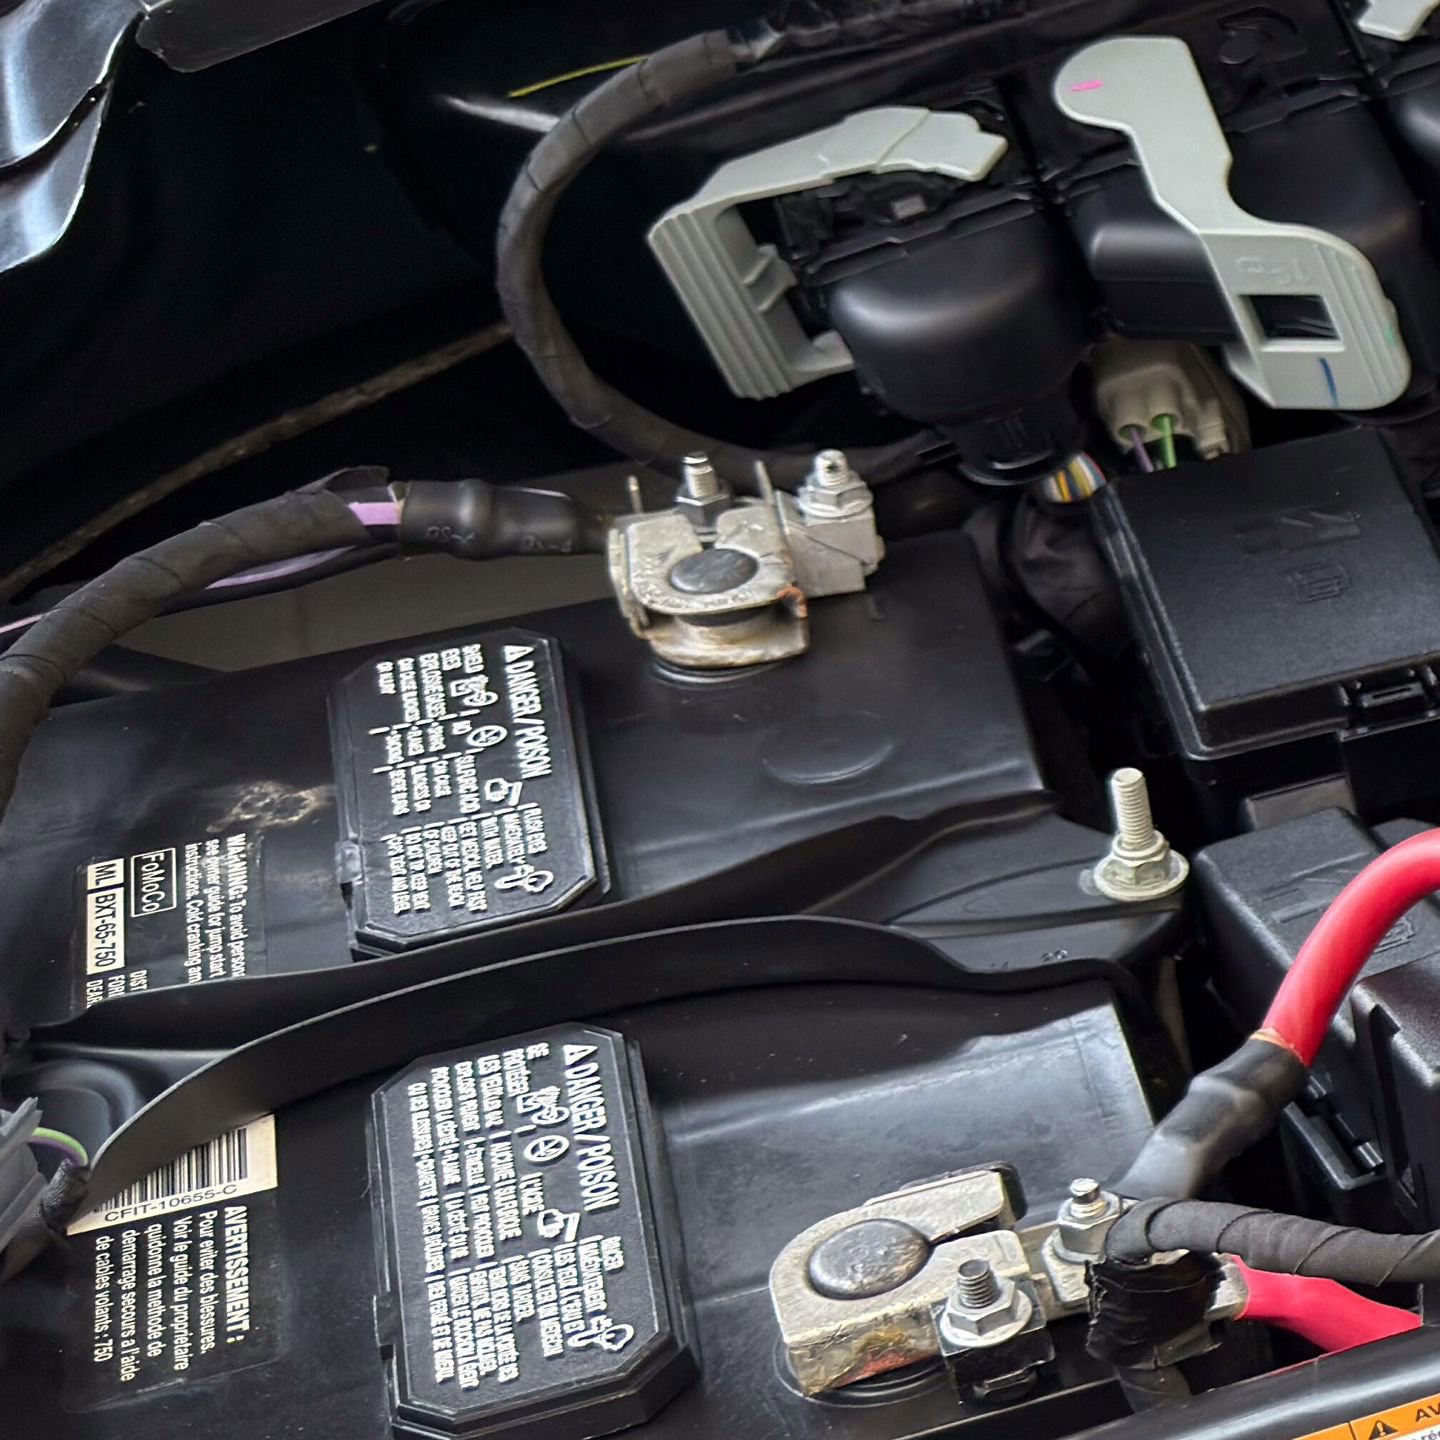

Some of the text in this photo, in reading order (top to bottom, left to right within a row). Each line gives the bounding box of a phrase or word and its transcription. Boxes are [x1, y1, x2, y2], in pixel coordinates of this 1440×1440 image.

[95, 862, 116, 968] ML BXT-65-750
[141, 851, 165, 913] FoMoCo
[183, 842, 203, 966] instructions. Cold cranking
[203, 837, 225, 977] see owner guide for jump start
[229, 899, 246, 913] To
[229, 911, 247, 940] avoid
[103, 1180, 238, 1225] CFIT-10655-C
[94, 1234, 113, 1362] de cables volants 750
[117, 1227, 140, 1382] demarrage secours a l'aide
[144, 1221, 166, 1357] quidonne la methode de
[169, 1215, 192, 1372] Voir le guide du proprietaire
[198, 1209, 219, 1354] Pour eviter des blessures.
[224, 1203, 249, 1334] AVERTISSEMENT
